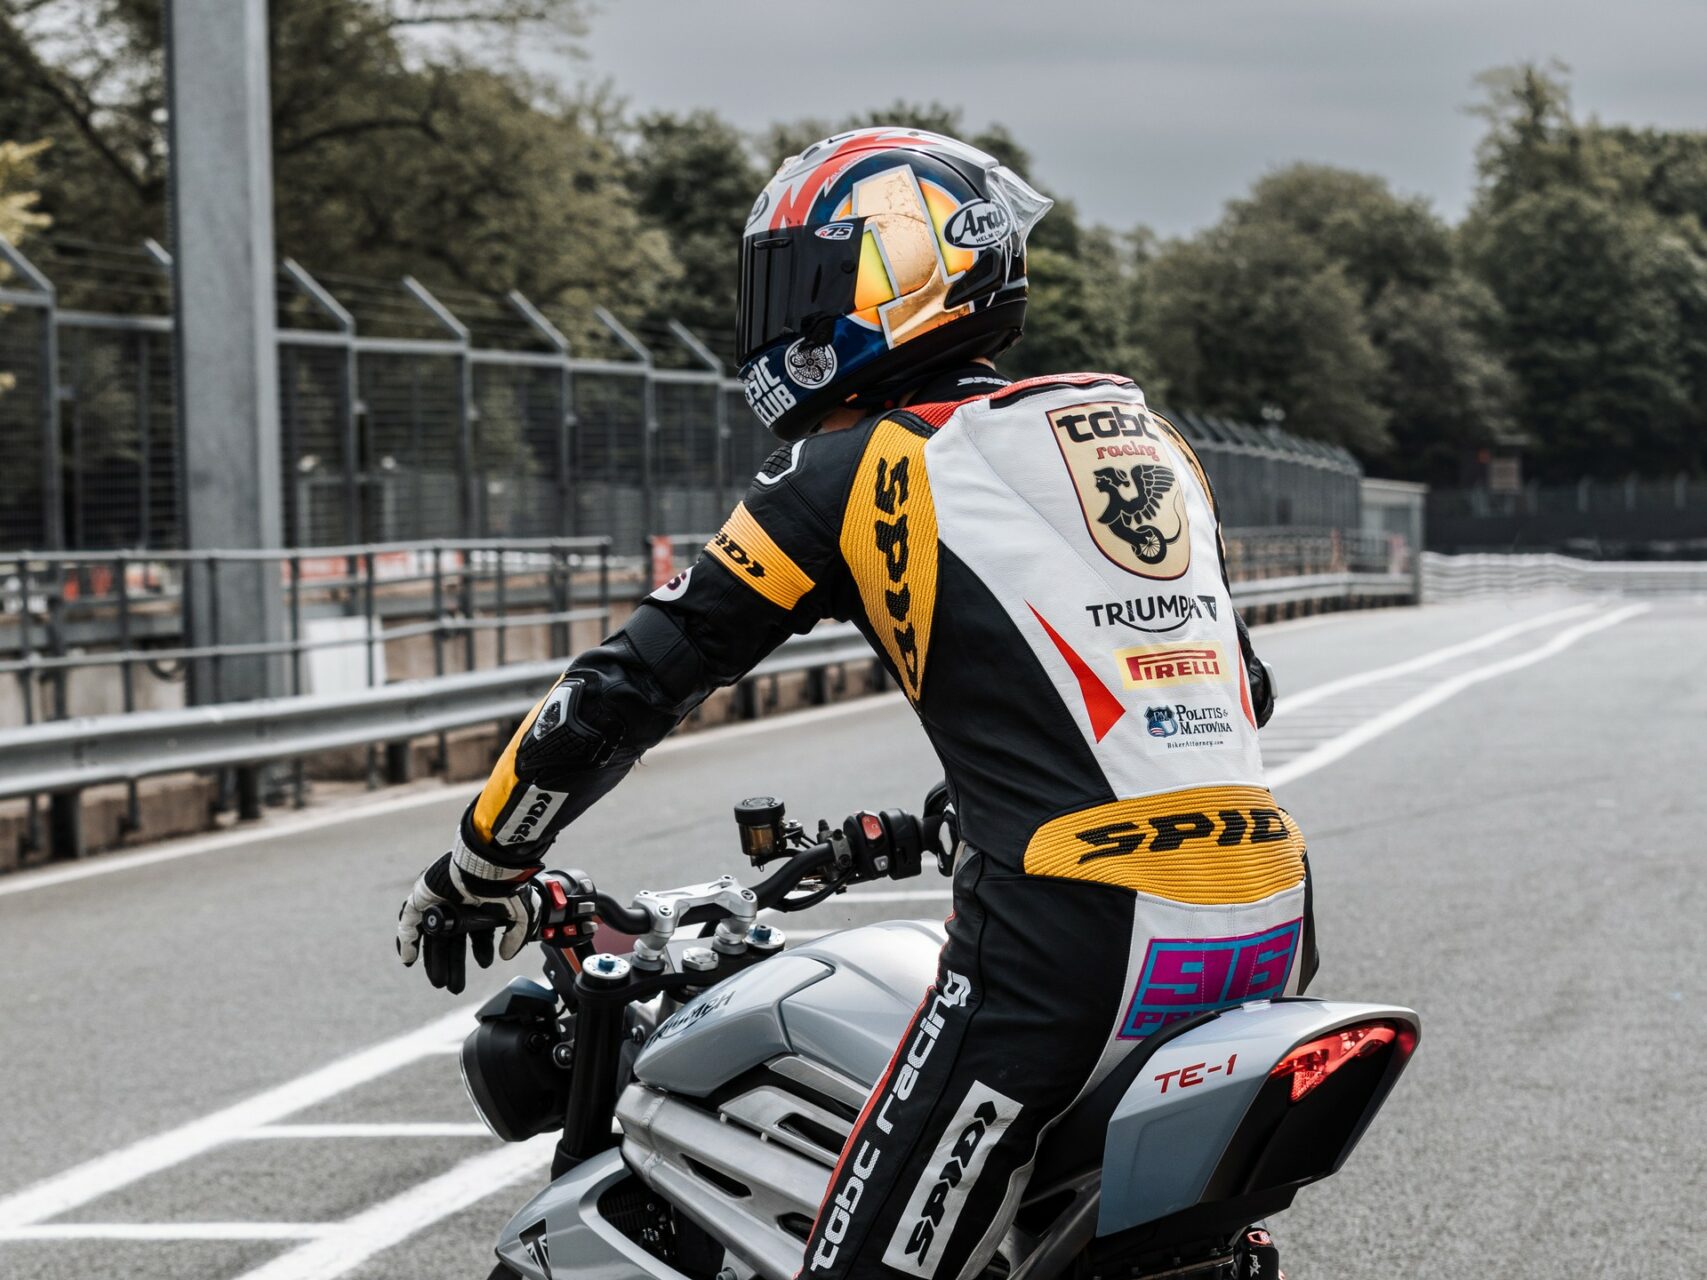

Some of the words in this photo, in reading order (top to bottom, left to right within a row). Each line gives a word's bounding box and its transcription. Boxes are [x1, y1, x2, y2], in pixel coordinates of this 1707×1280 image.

[753, 384, 797, 428] CLUB
[1096, 440, 1160, 462] racing
[1085, 594, 1203, 633] TRIUMPH
[1126, 649, 1220, 681] PIRELLI
[1141, 930, 1293, 1007] 96
[1154, 1053, 1238, 1094] TE-1
[905, 1100, 997, 1267] SPIDI
